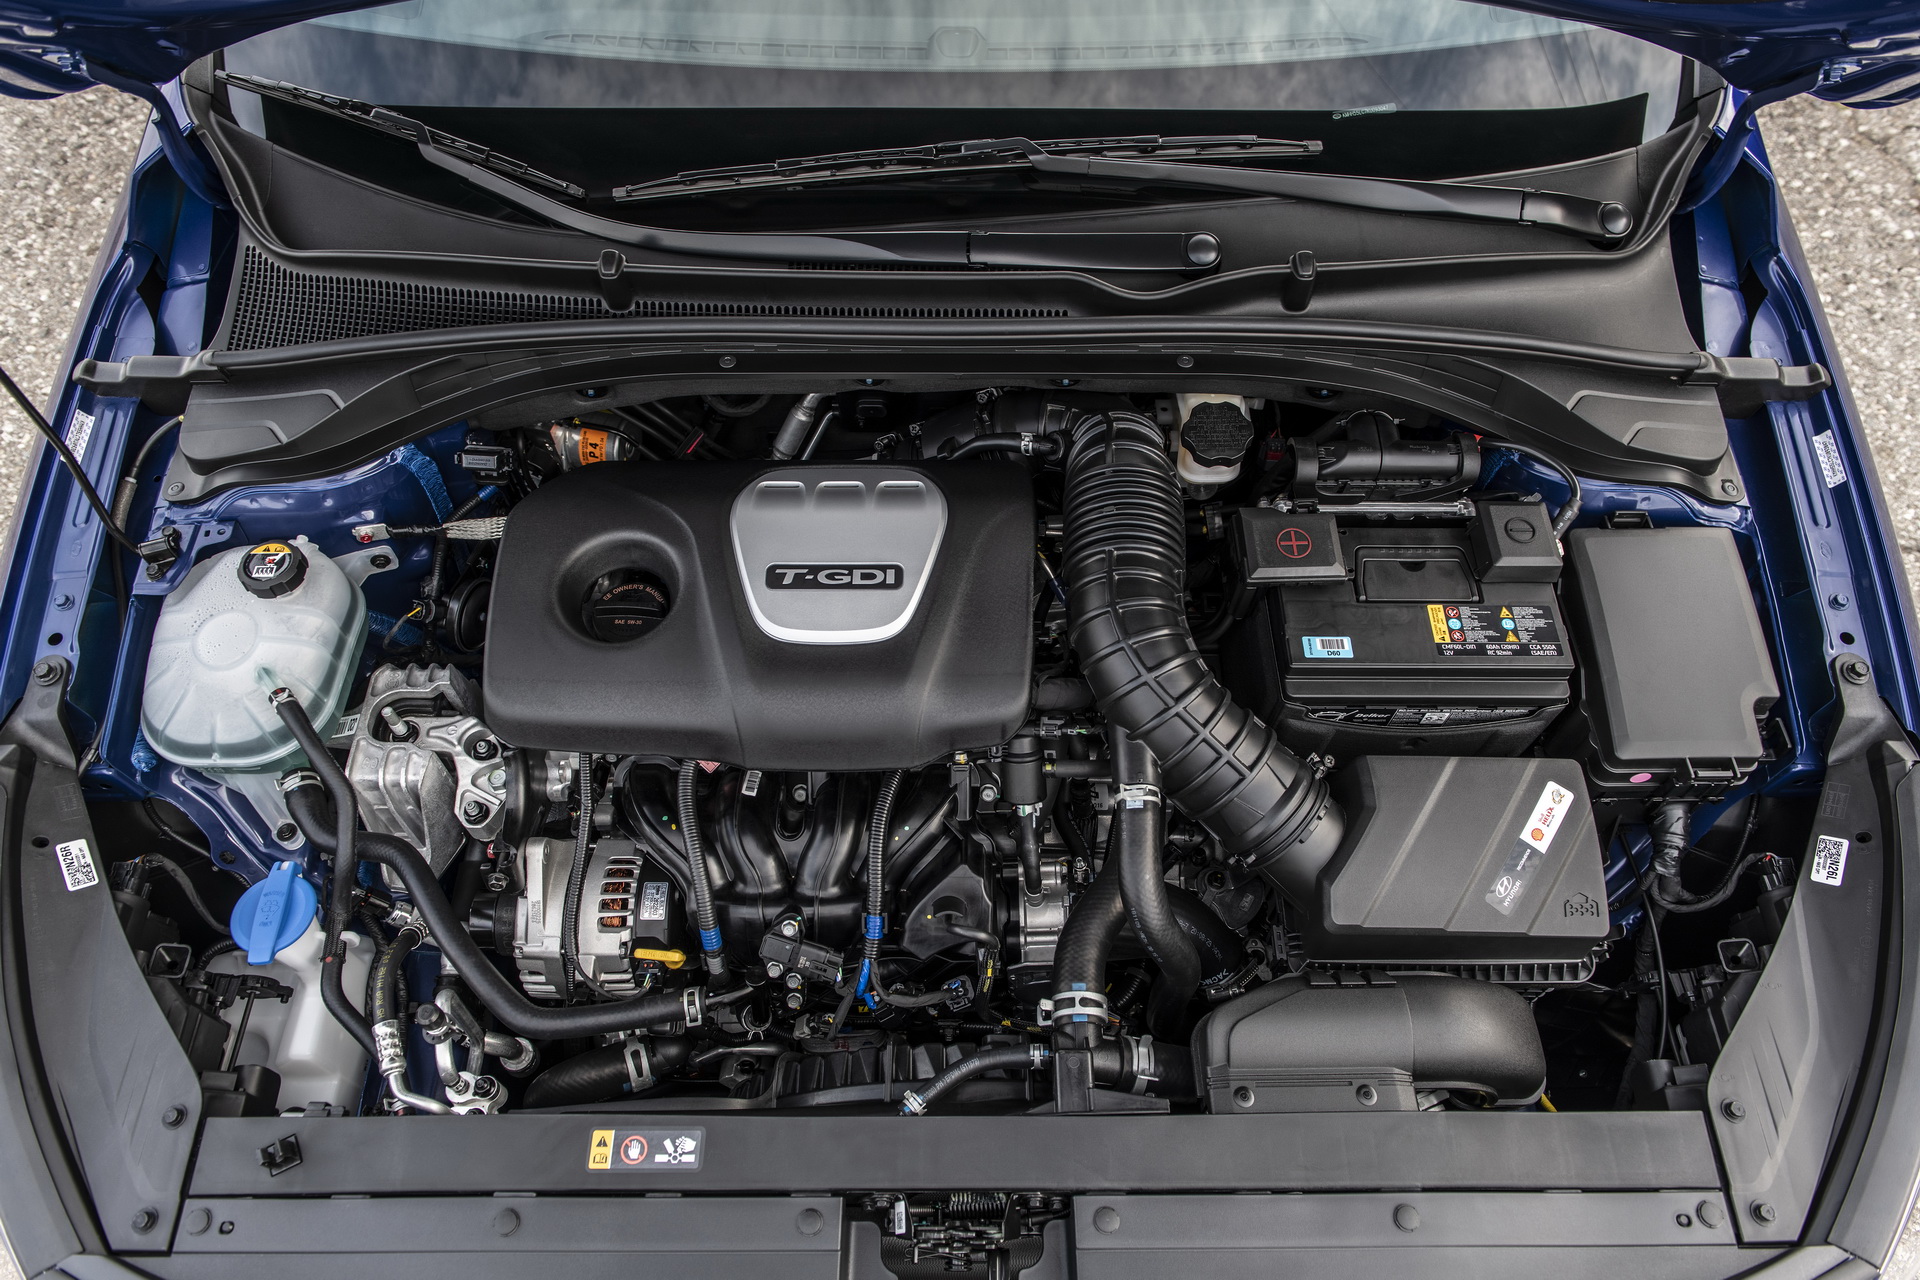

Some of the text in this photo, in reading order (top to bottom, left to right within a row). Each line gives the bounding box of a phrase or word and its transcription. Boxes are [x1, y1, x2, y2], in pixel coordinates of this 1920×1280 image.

[775, 569, 895, 585] T-GDI
[603, 592, 613, 601] EE
[613, 583, 644, 594] OWNER'S
[1542, 806, 1555, 826] HELIX
[60, 845, 76, 869] N26R
[1825, 859, 1840, 880] N26L
[1503, 879, 1522, 907] HYUNDAI
